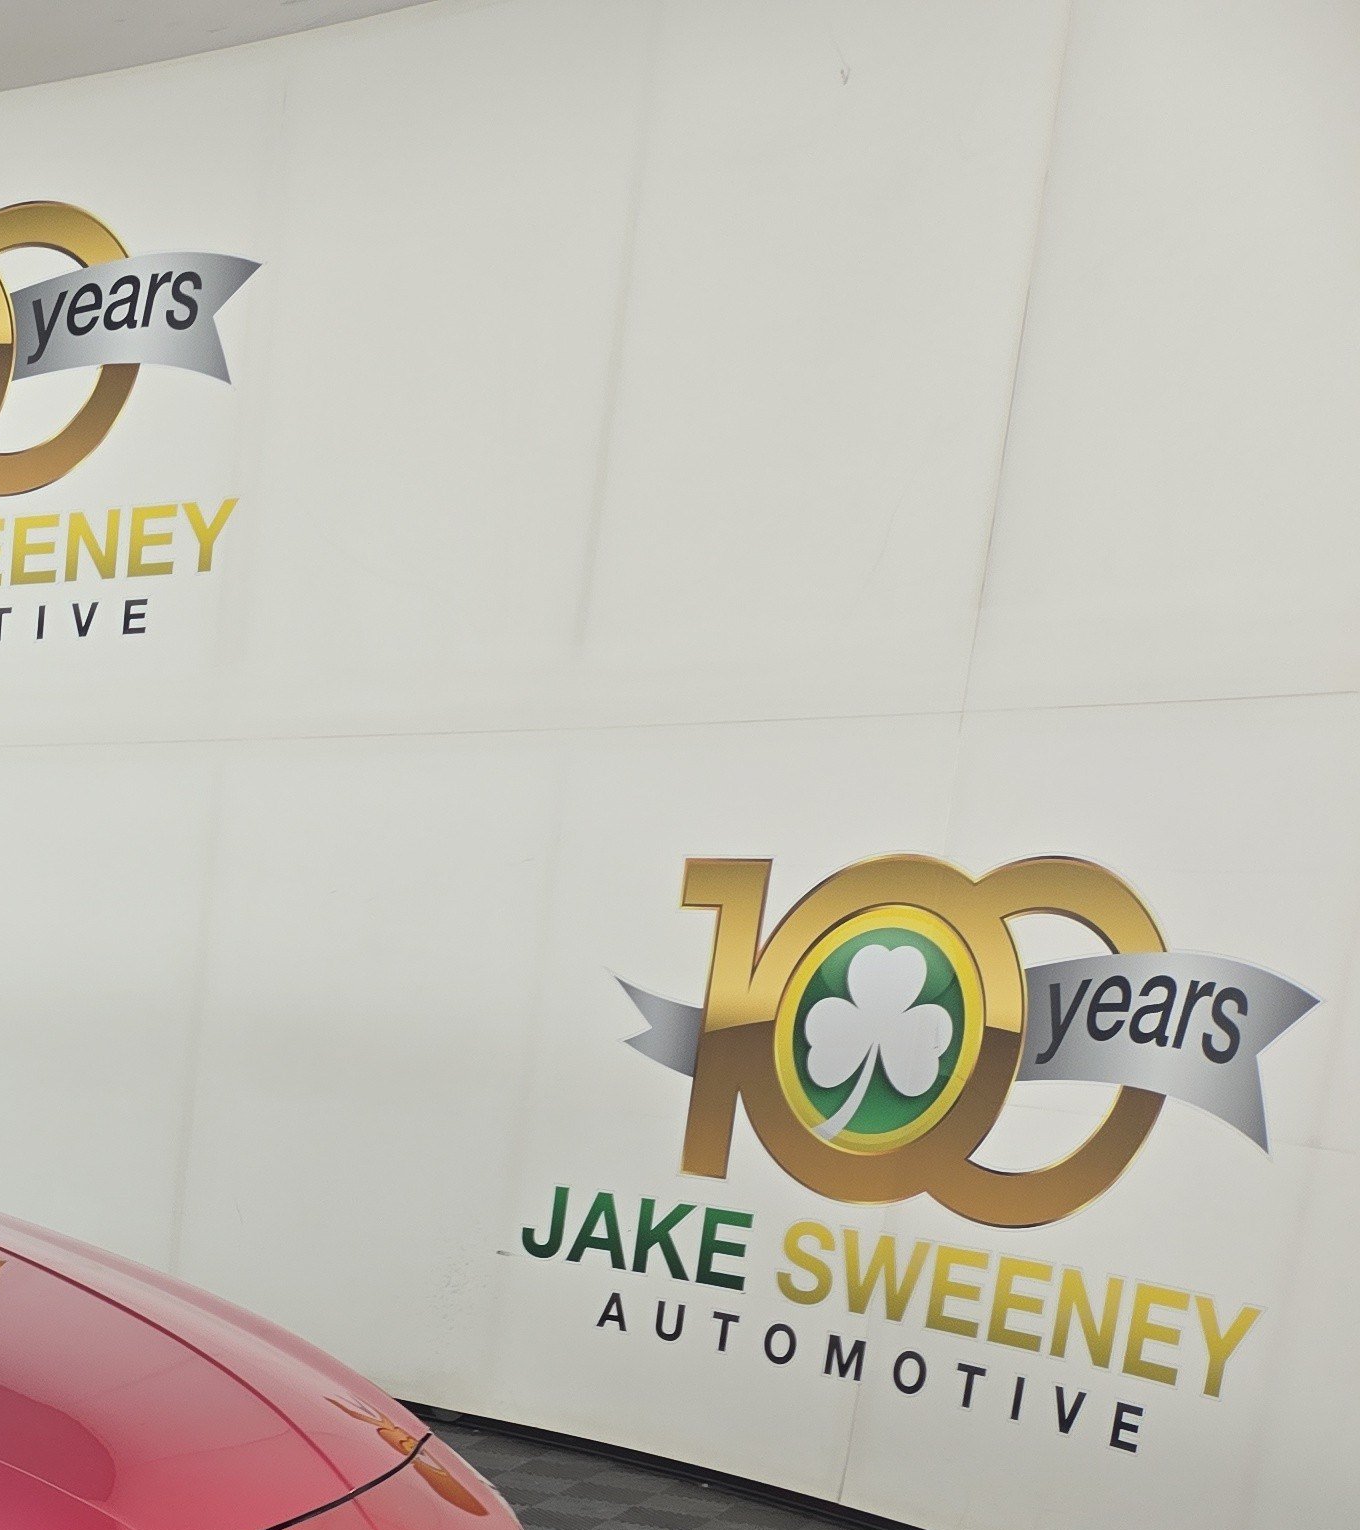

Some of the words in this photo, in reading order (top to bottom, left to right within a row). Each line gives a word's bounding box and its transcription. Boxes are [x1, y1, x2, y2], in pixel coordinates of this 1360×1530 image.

[27, 269, 202, 364] years
[1035, 973, 1247, 1065] years
[521, 1186, 755, 1292] JAKE
[776, 1221, 1262, 1398] SWEENEY
[597, 1292, 1146, 1453] AUTOMOTIVE
